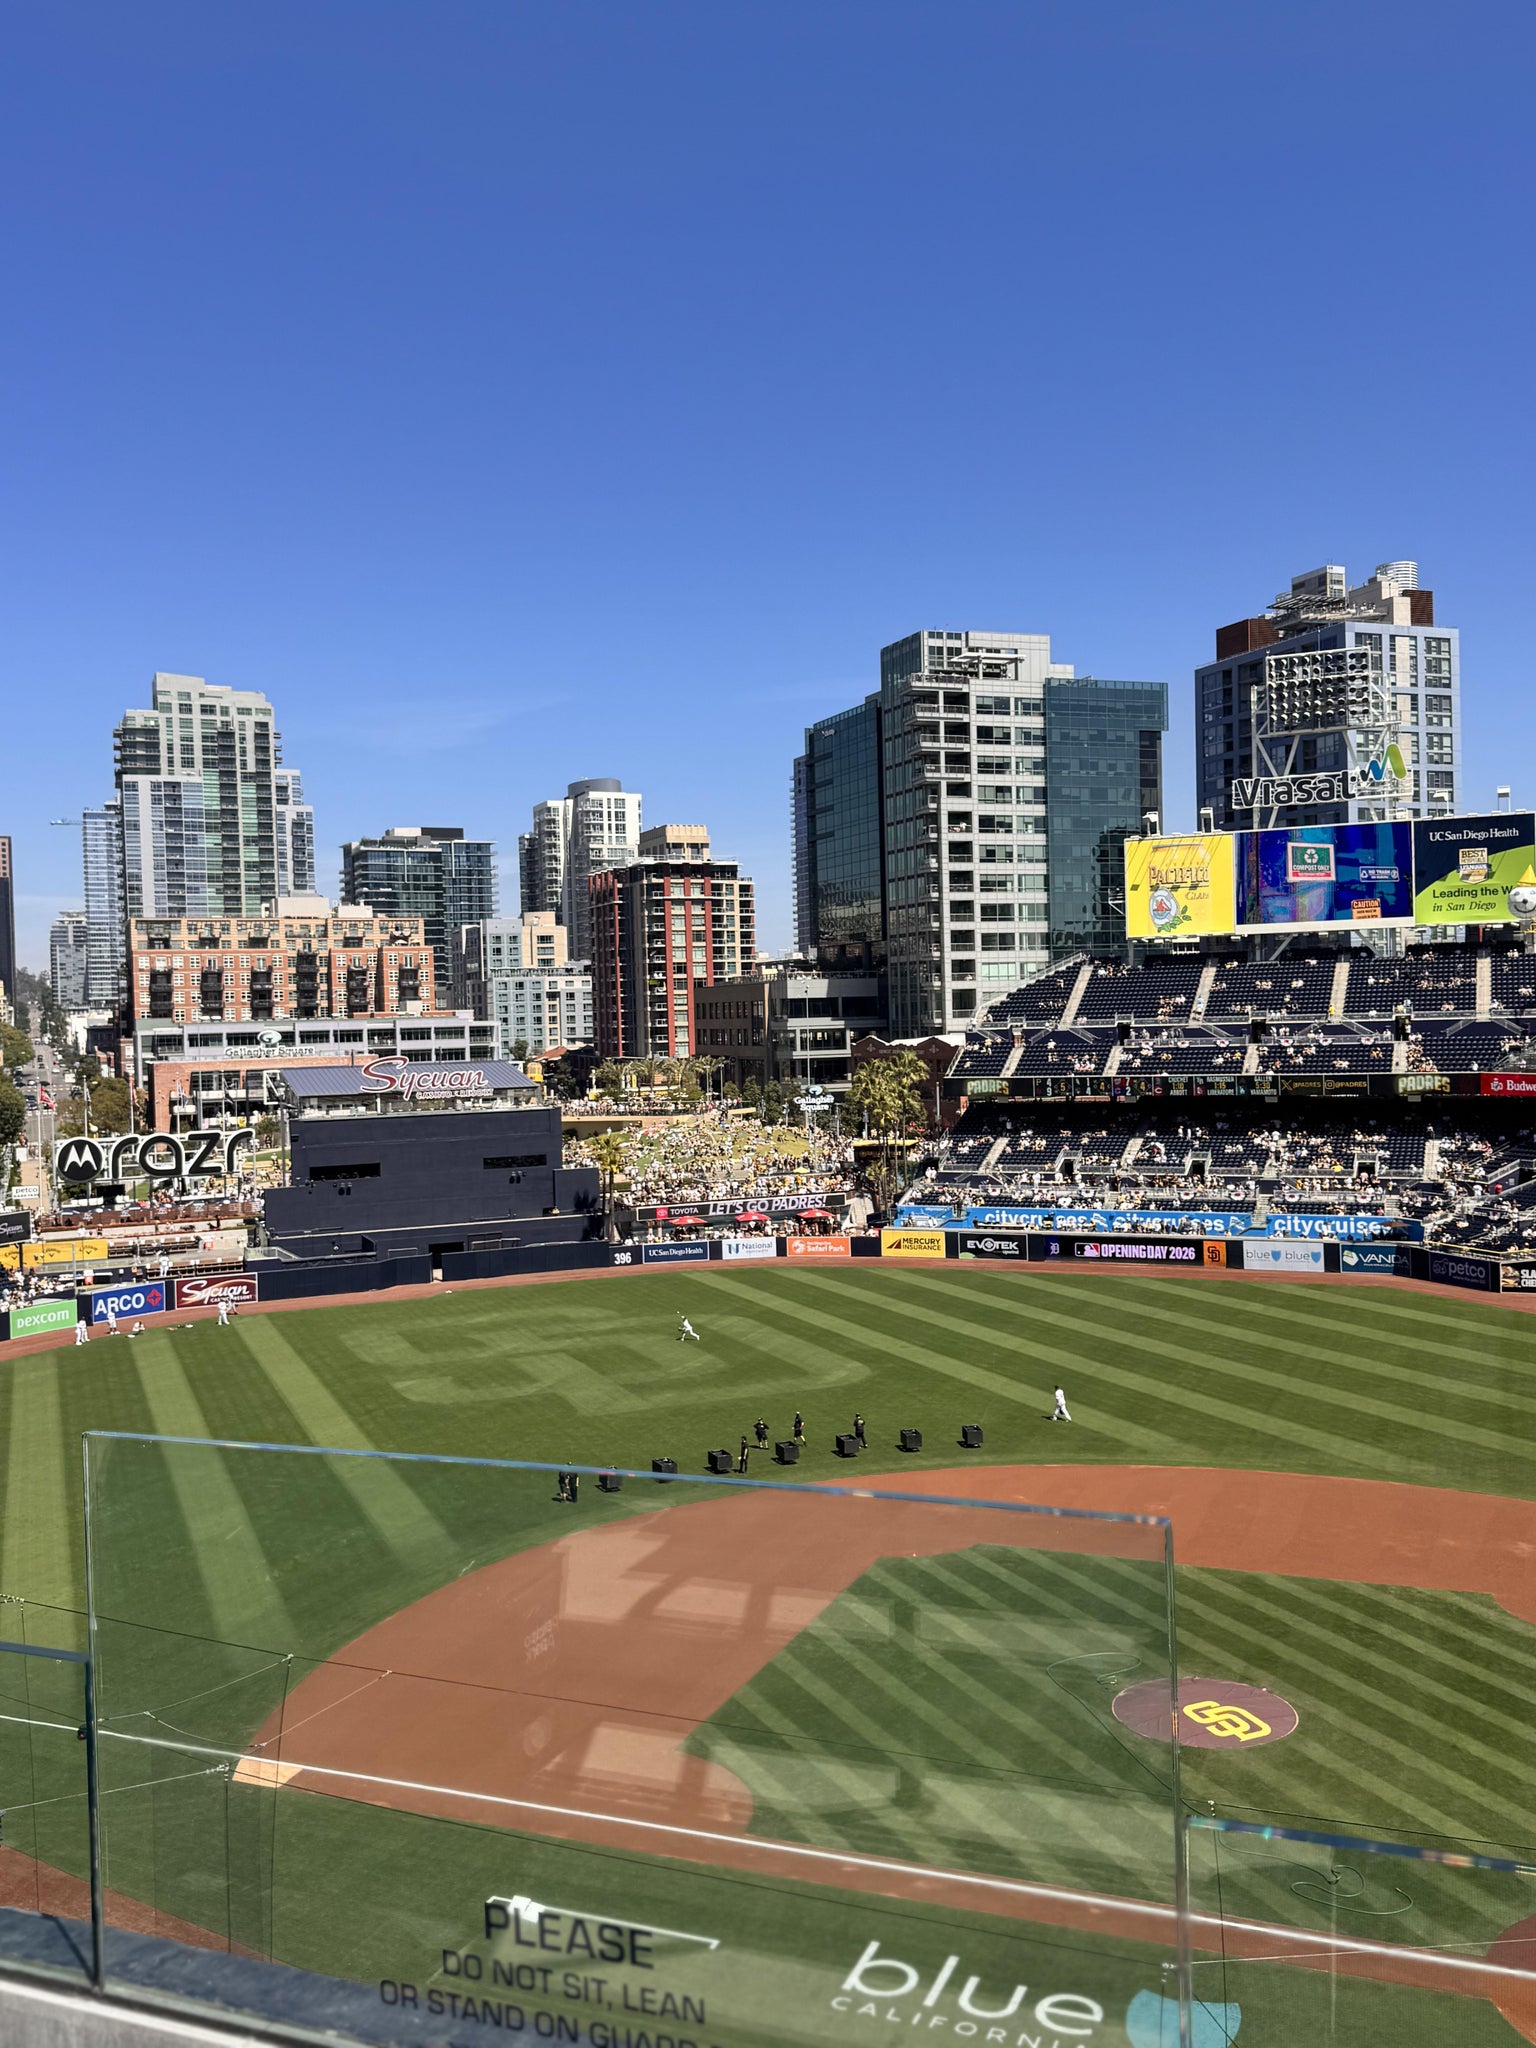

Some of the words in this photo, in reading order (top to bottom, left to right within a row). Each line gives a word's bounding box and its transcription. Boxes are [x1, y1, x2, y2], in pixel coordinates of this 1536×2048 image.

[1236, 770, 1356, 807] Viasat
[1429, 831, 1445, 842] UC
[1445, 830, 1463, 841] San
[1463, 829, 1489, 841] Diego
[1489, 827, 1520, 838] Health
[1461, 850, 1486, 858] BEST
[1432, 887, 1478, 899] Leading
[1480, 886, 1499, 897] the
[1353, 899, 1379, 909] CAUTION
[1432, 902, 1443, 912] in
[1446, 902, 1465, 912] San
[1469, 901, 1497, 912] Diego
[225, 1047, 276, 1057] Gallagher
[278, 1046, 314, 1057] Square
[361, 1055, 489, 1101] Sycuan
[1126, 1078, 1132, 1087] 7
[967, 1080, 1010, 1096] PADRES
[1060, 1082, 1066, 1092] 5
[1099, 1081, 1106, 1092] 4
[1140, 1081, 1146, 1092] 4
[1293, 1081, 1322, 1089] @PADRES
[1335, 1081, 1368, 1089] @PADRES
[1398, 1075, 1451, 1093] PADRES
[1046, 1087, 1053, 1097] 9
[1126, 1087, 1132, 1096] 2
[794, 1096, 834, 1105] Gallagher
[800, 1103, 829, 1112] Square
[111, 1130, 255, 1179] razr
[670, 1207, 699, 1216] TOYOTA
[708, 1201, 744, 1216] LET'S
[746, 1199, 769, 1213] GO
[771, 1195, 827, 1212] PADRES!
[741, 1241, 773, 1251] National
[902, 1237, 941, 1245] MERCURY
[967, 1238, 1019, 1252] EVOTEK
[649, 1249, 658, 1257] UC
[658, 1248, 670, 1256] San
[669, 1248, 686, 1257] Diego
[685, 1247, 704, 1255] Health
[1101, 1243, 1147, 1258] OPENING
[1147, 1245, 1168, 1259] DAY
[1168, 1246, 1196, 1260] 2026
[1246, 1249, 1271, 1259] blue
[1285, 1250, 1310, 1260] blue
[614, 1252, 632, 1265] 396
[1359, 1253, 1409, 1264] VANDA
[1448, 1261, 1486, 1278] petco
[181, 1279, 250, 1304] Sycuan
[94, 1292, 145, 1316] ARCO
[484, 1900, 655, 1970] PLEASE
[442, 1948, 482, 1981] DO
[493, 1960, 554, 1995] NOT
[563, 1971, 614, 2011] SIT,
[623, 1983, 706, 2024] LEAN
[841, 1940, 1104, 2037] blue
[380, 1979, 420, 2010] OR
[427, 1988, 524, 2031] STAND
[534, 2010, 579, 2044] ON
